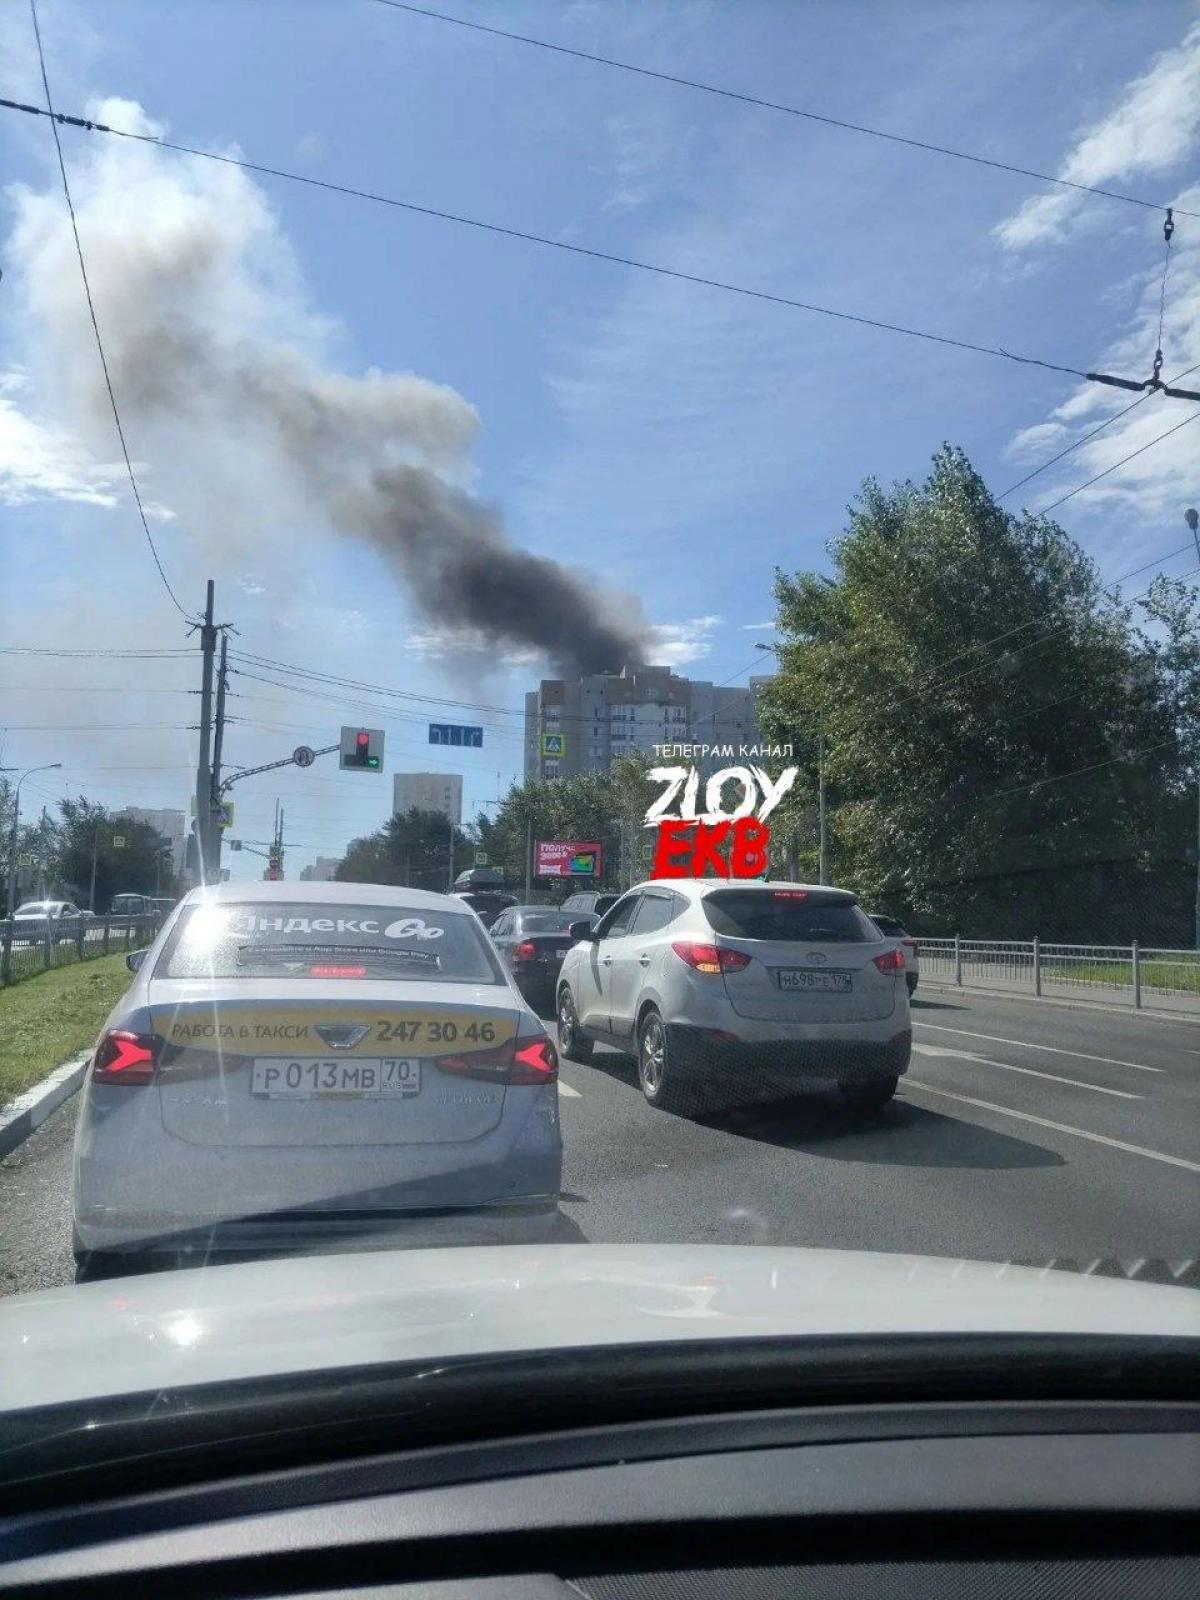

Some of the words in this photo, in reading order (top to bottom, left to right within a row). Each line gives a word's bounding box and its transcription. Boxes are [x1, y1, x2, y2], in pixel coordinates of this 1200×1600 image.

[172, 1023, 235, 1038] РАБОТА
[253, 1025, 308, 1038] ТАКСИ
[376, 1020, 418, 1042] 247
[427, 1022, 457, 1042] 30
[464, 1022, 496, 1042] 46
